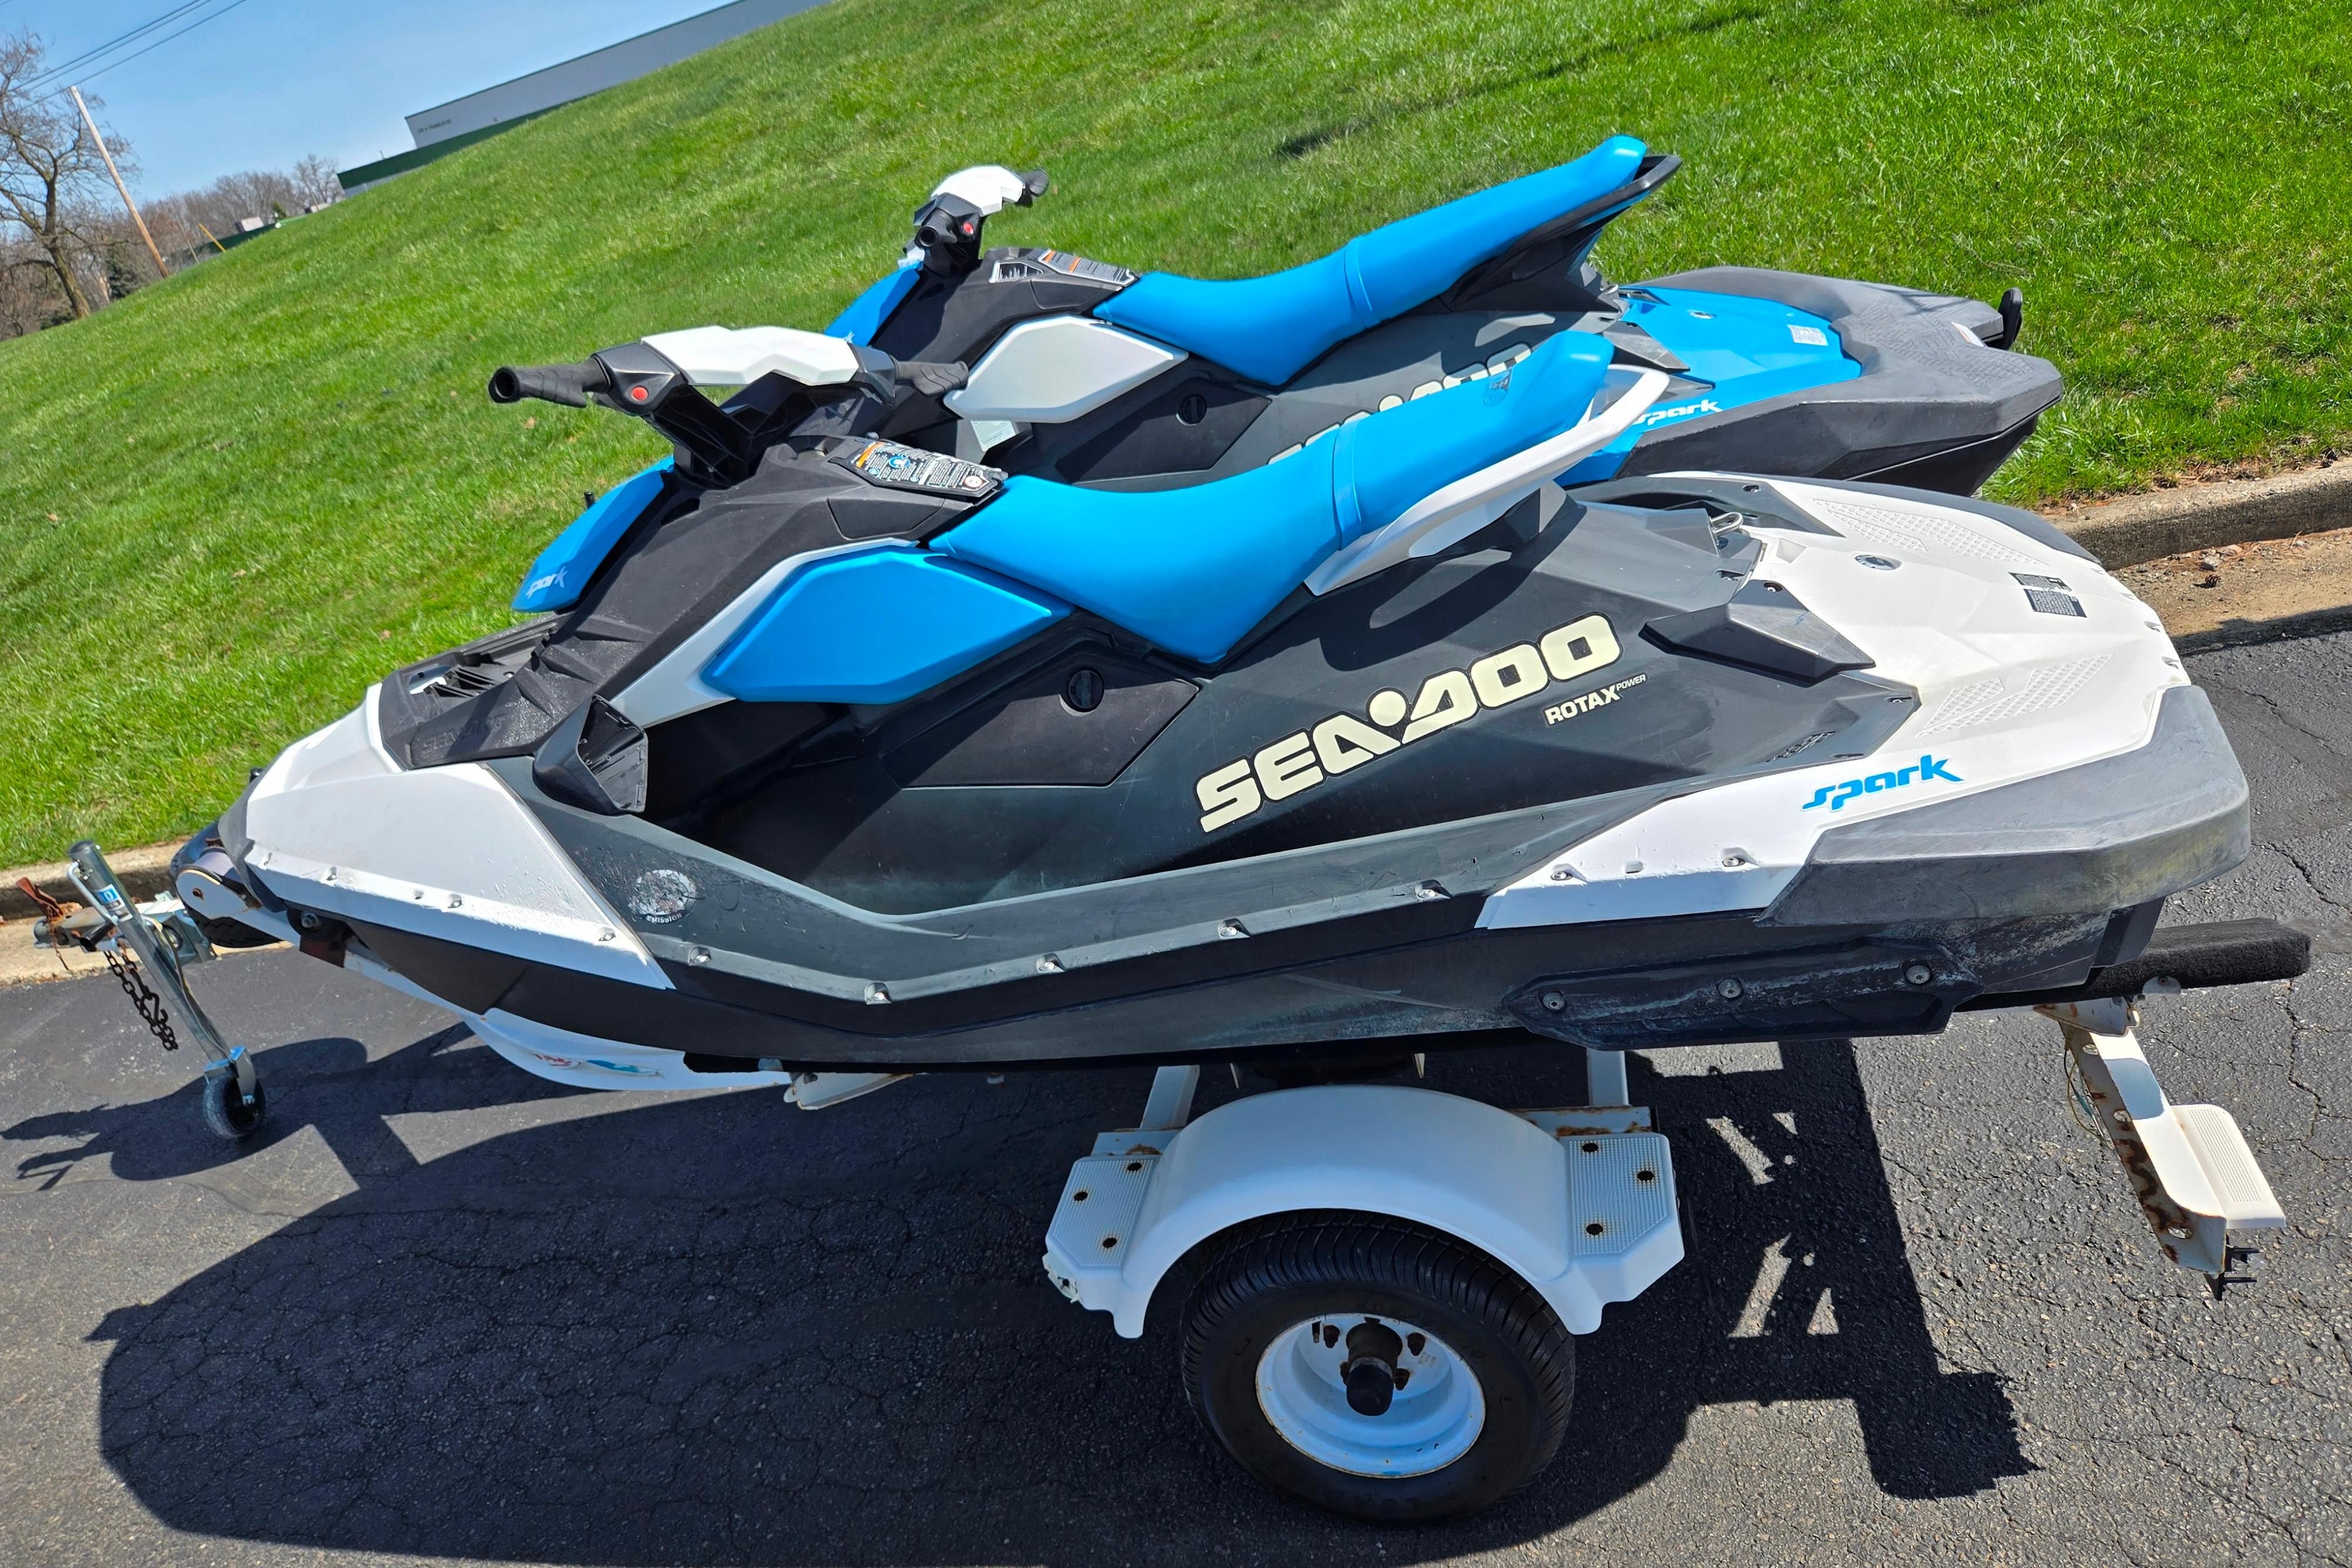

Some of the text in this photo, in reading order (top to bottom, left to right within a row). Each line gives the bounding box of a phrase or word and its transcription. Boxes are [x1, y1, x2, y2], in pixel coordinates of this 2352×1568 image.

[1632, 399, 1723, 426] spark
[1545, 674, 1646, 725] ROTAX POWER
[1802, 754, 1966, 811] spark
